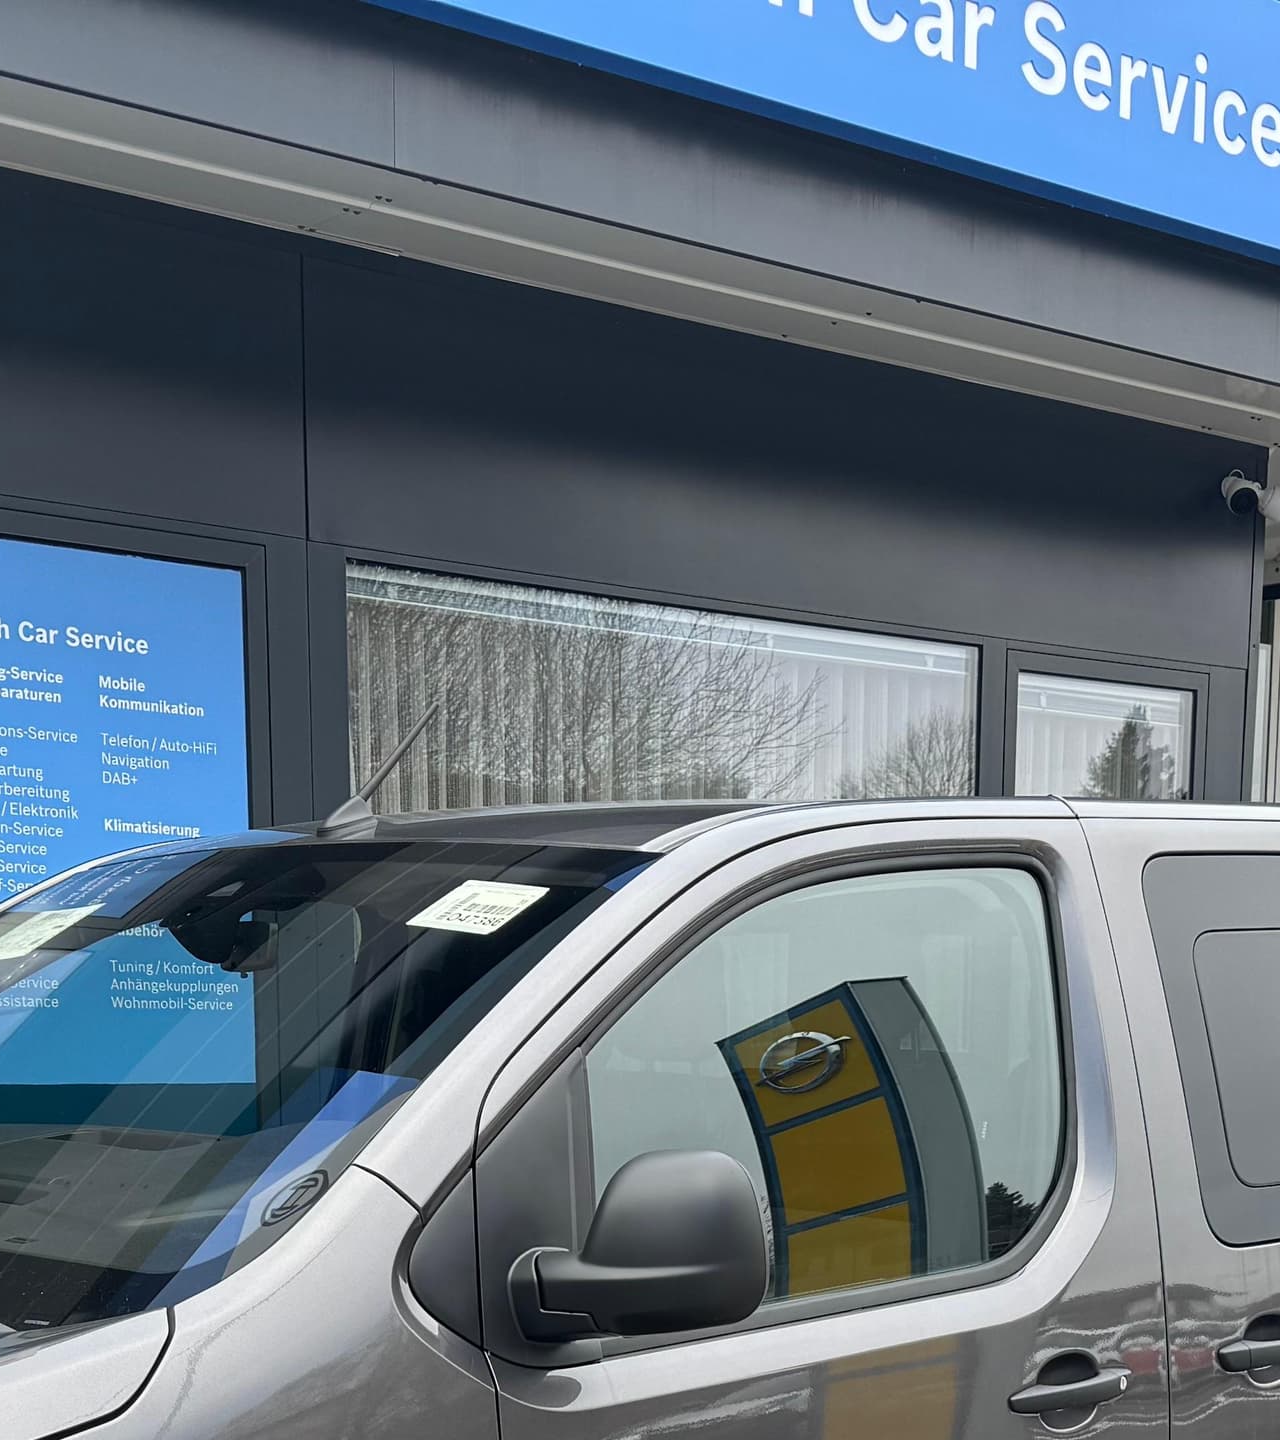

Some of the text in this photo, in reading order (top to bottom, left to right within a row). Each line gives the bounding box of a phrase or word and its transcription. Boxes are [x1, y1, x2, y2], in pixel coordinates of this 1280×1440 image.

[18, 620, 58, 645] Car
[65, 626, 150, 655] Service
[99, 675, 146, 692] Mobile
[99, 695, 205, 717] Kommunikation
[100, 732, 149, 750] Telefon
[159, 738, 217, 755] Auto-HiFi
[101, 751, 170, 770] Navigation
[102, 771, 138, 785] DAB+
[10, 802, 79, 820] Elektronik
[104, 818, 201, 838] Klimatisierung
[109, 960, 153, 976] Tuning
[163, 961, 214, 975] Komfort
[110, 978, 239, 995] Anhängekupplungen
[110, 996, 233, 1010] Wohnmobil-Service
